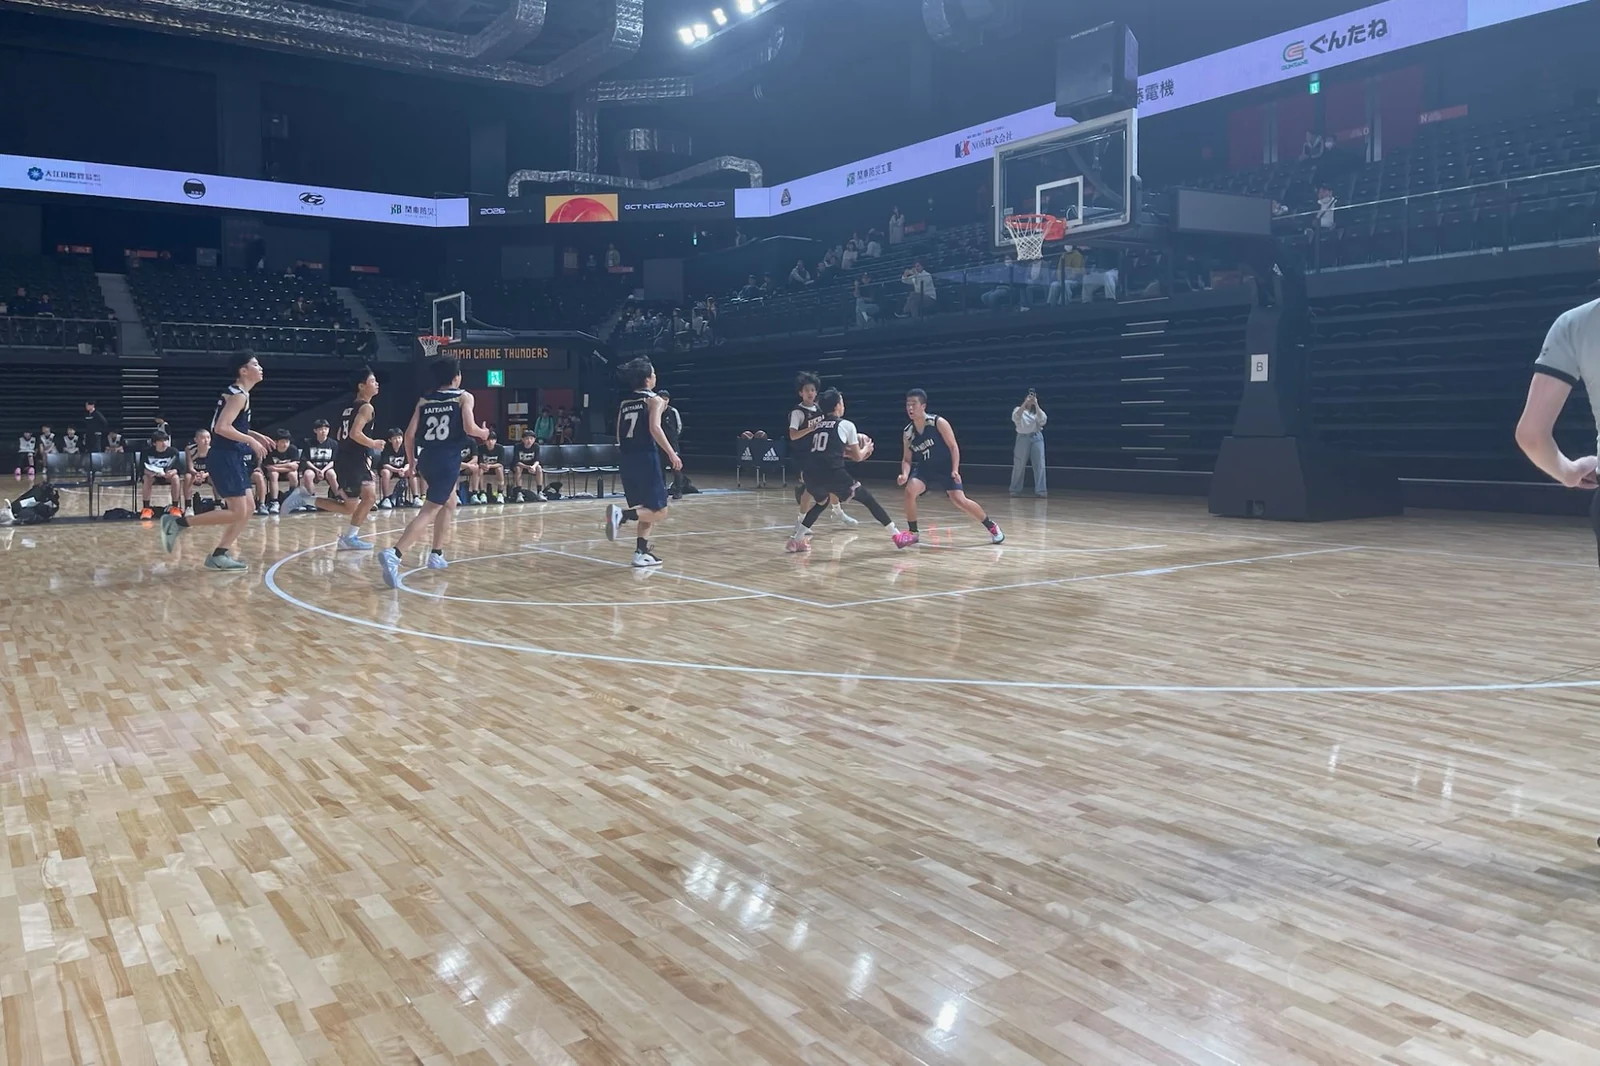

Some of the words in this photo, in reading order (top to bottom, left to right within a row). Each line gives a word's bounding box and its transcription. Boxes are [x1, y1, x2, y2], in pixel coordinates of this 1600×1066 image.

[1309, 18, 1388, 54] ぐんたね
[624, 202, 641, 210] GCT
[642, 200, 706, 210] INTERNATIONAL
[473, 347, 502, 359] CRANE
[503, 347, 549, 359] THUNDERS
[1256, 361, 1264, 371] B
[424, 405, 453, 415] SAITAMA
[424, 414, 450, 441] 28
[624, 411, 639, 438] 7
